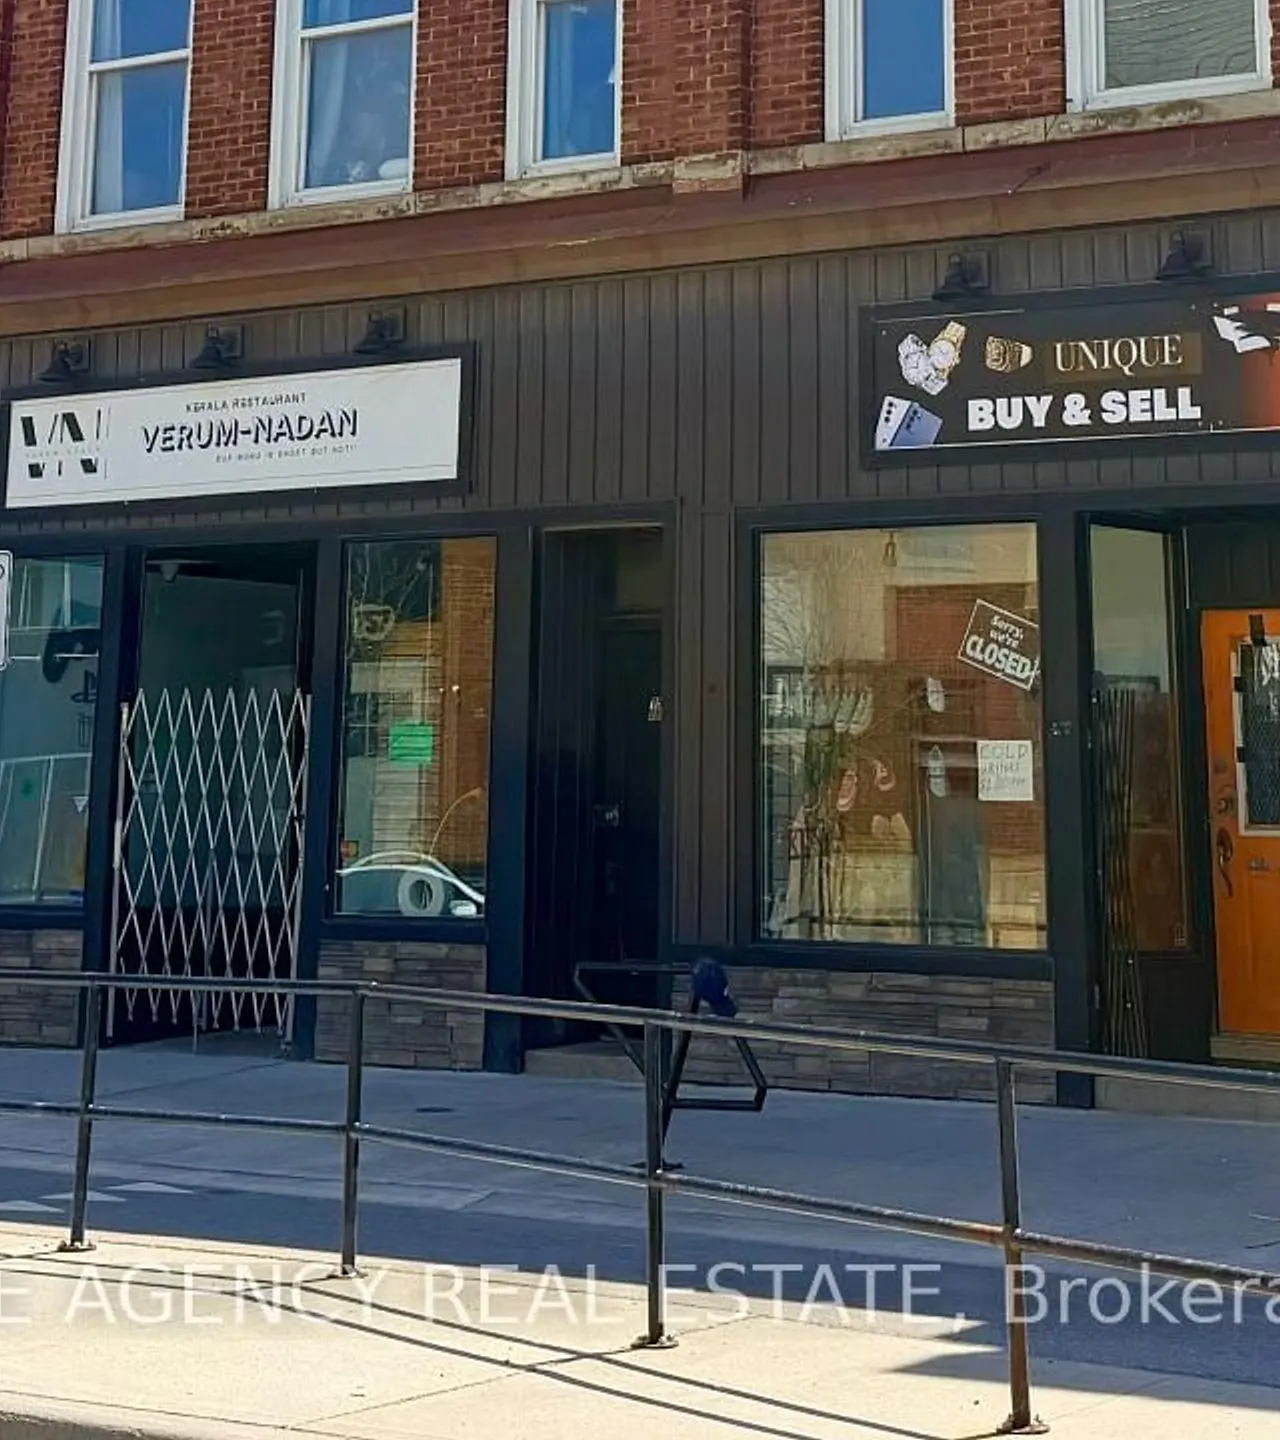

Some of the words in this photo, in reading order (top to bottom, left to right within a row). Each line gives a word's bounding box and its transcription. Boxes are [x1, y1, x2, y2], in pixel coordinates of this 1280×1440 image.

[1054, 334, 1183, 376] UNIQUE
[185, 399, 229, 413] KERALA
[231, 392, 307, 410] RESTAURANT
[967, 395, 1053, 431] BUY
[1062, 392, 1092, 426] &
[1100, 387, 1202, 425] SELL
[143, 408, 359, 453] VERUM-NADAN
[965, 634, 1032, 679] CLOSED
